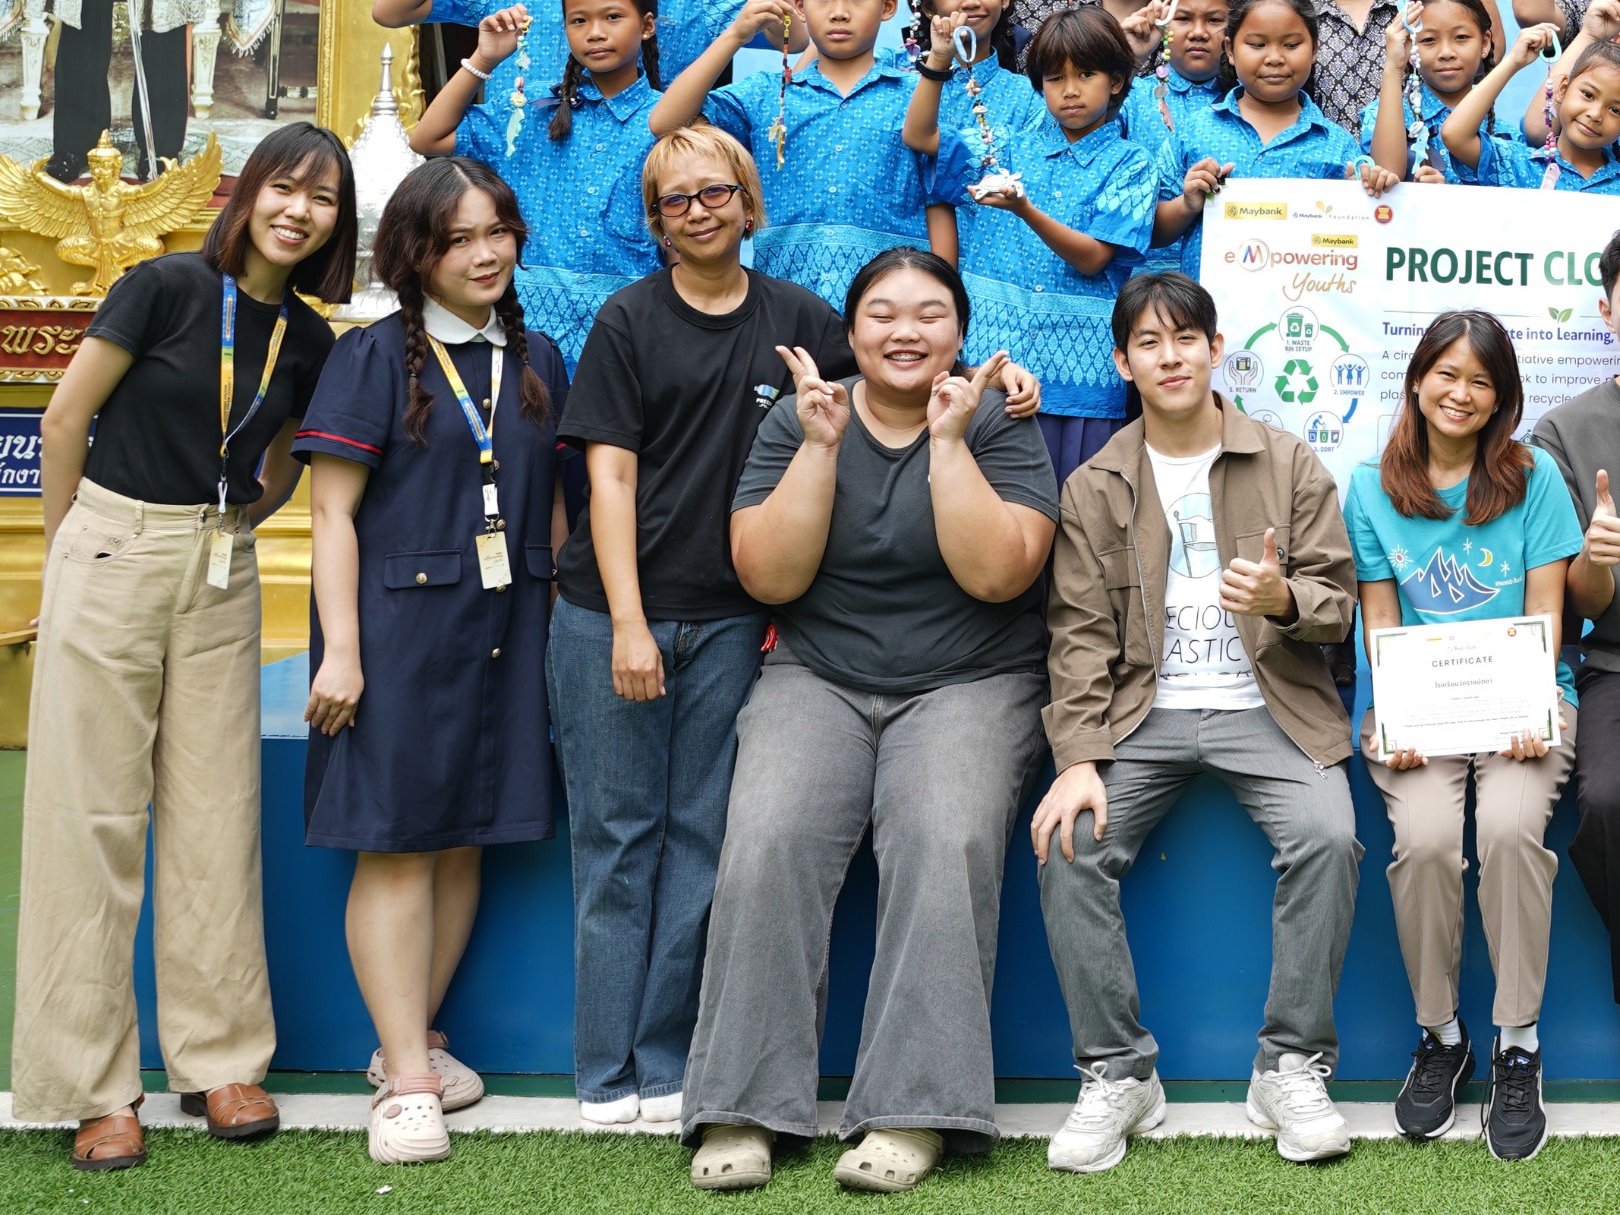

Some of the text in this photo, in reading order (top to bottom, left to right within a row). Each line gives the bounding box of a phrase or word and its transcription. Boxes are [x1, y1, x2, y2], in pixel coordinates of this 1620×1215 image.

[1239, 207, 1282, 217] Maybank
[1322, 237, 1354, 246] Maybank
[1386, 246, 1534, 287] PROJECT
[1543, 250, 1603, 287] CLO
[1282, 272, 1357, 302] Youths
[1382, 321, 1426, 337] Turnin
[1526, 327, 1553, 340] into
[1557, 327, 1614, 345] Learning,
[1382, 350, 1390, 360] A
[1517, 354, 1554, 365] tiative
[1535, 374, 1548, 384] to
[1551, 373, 1601, 387] improve
[1380, 389, 1406, 403] plas
[1162, 636, 1242, 664] ASTIC
[1432, 655, 1493, 668] CERTIFICATE
